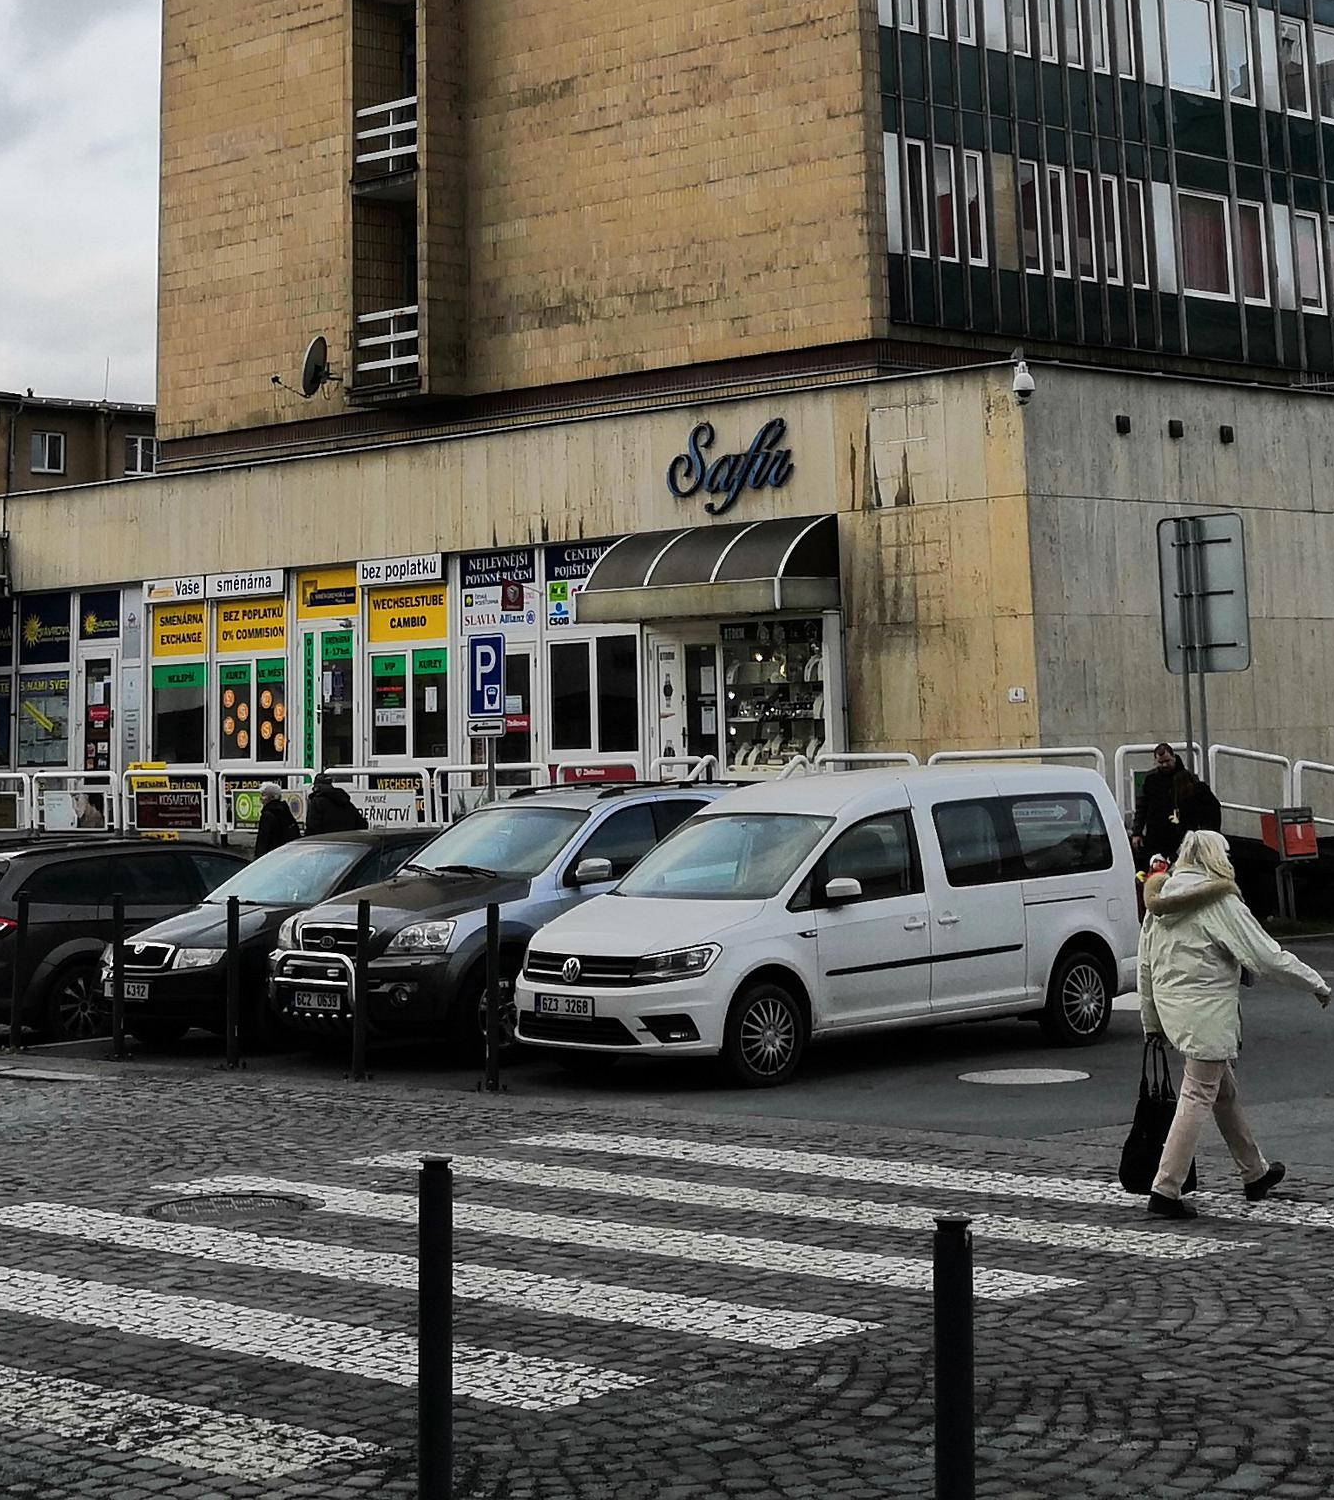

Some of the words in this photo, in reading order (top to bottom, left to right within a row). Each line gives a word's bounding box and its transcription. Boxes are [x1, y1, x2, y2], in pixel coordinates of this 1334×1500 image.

[564, 545, 610, 561] CENTRU
[361, 563, 381, 579] bez
[385, 557, 437, 581] poplatků
[469, 551, 528, 572] NEJLEVNĚJŠÍ
[554, 562, 594, 578] POJIŠTĚN
[175, 579, 200, 596] Vaše
[217, 574, 272, 592] směnárna
[373, 594, 444, 610] WECHSELSTUBE
[223, 610, 240, 622] BEZ
[242, 603, 283, 621] POPLATKŮ
[465, 613, 497, 626] SLAVIA
[499, 613, 525, 625] Allianz
[390, 615, 427, 629] CAMBIO
[161, 632, 202, 645] EXCHANGE
[236, 626, 284, 640] COMMISION
[475, 645, 497, 691] P
[159, 794, 200, 805] KOSMETIKA
[359, 805, 411, 821] DEŘNICTVÍ
[542, 993, 559, 1009] 6Z3
[565, 995, 589, 1014] 3268
